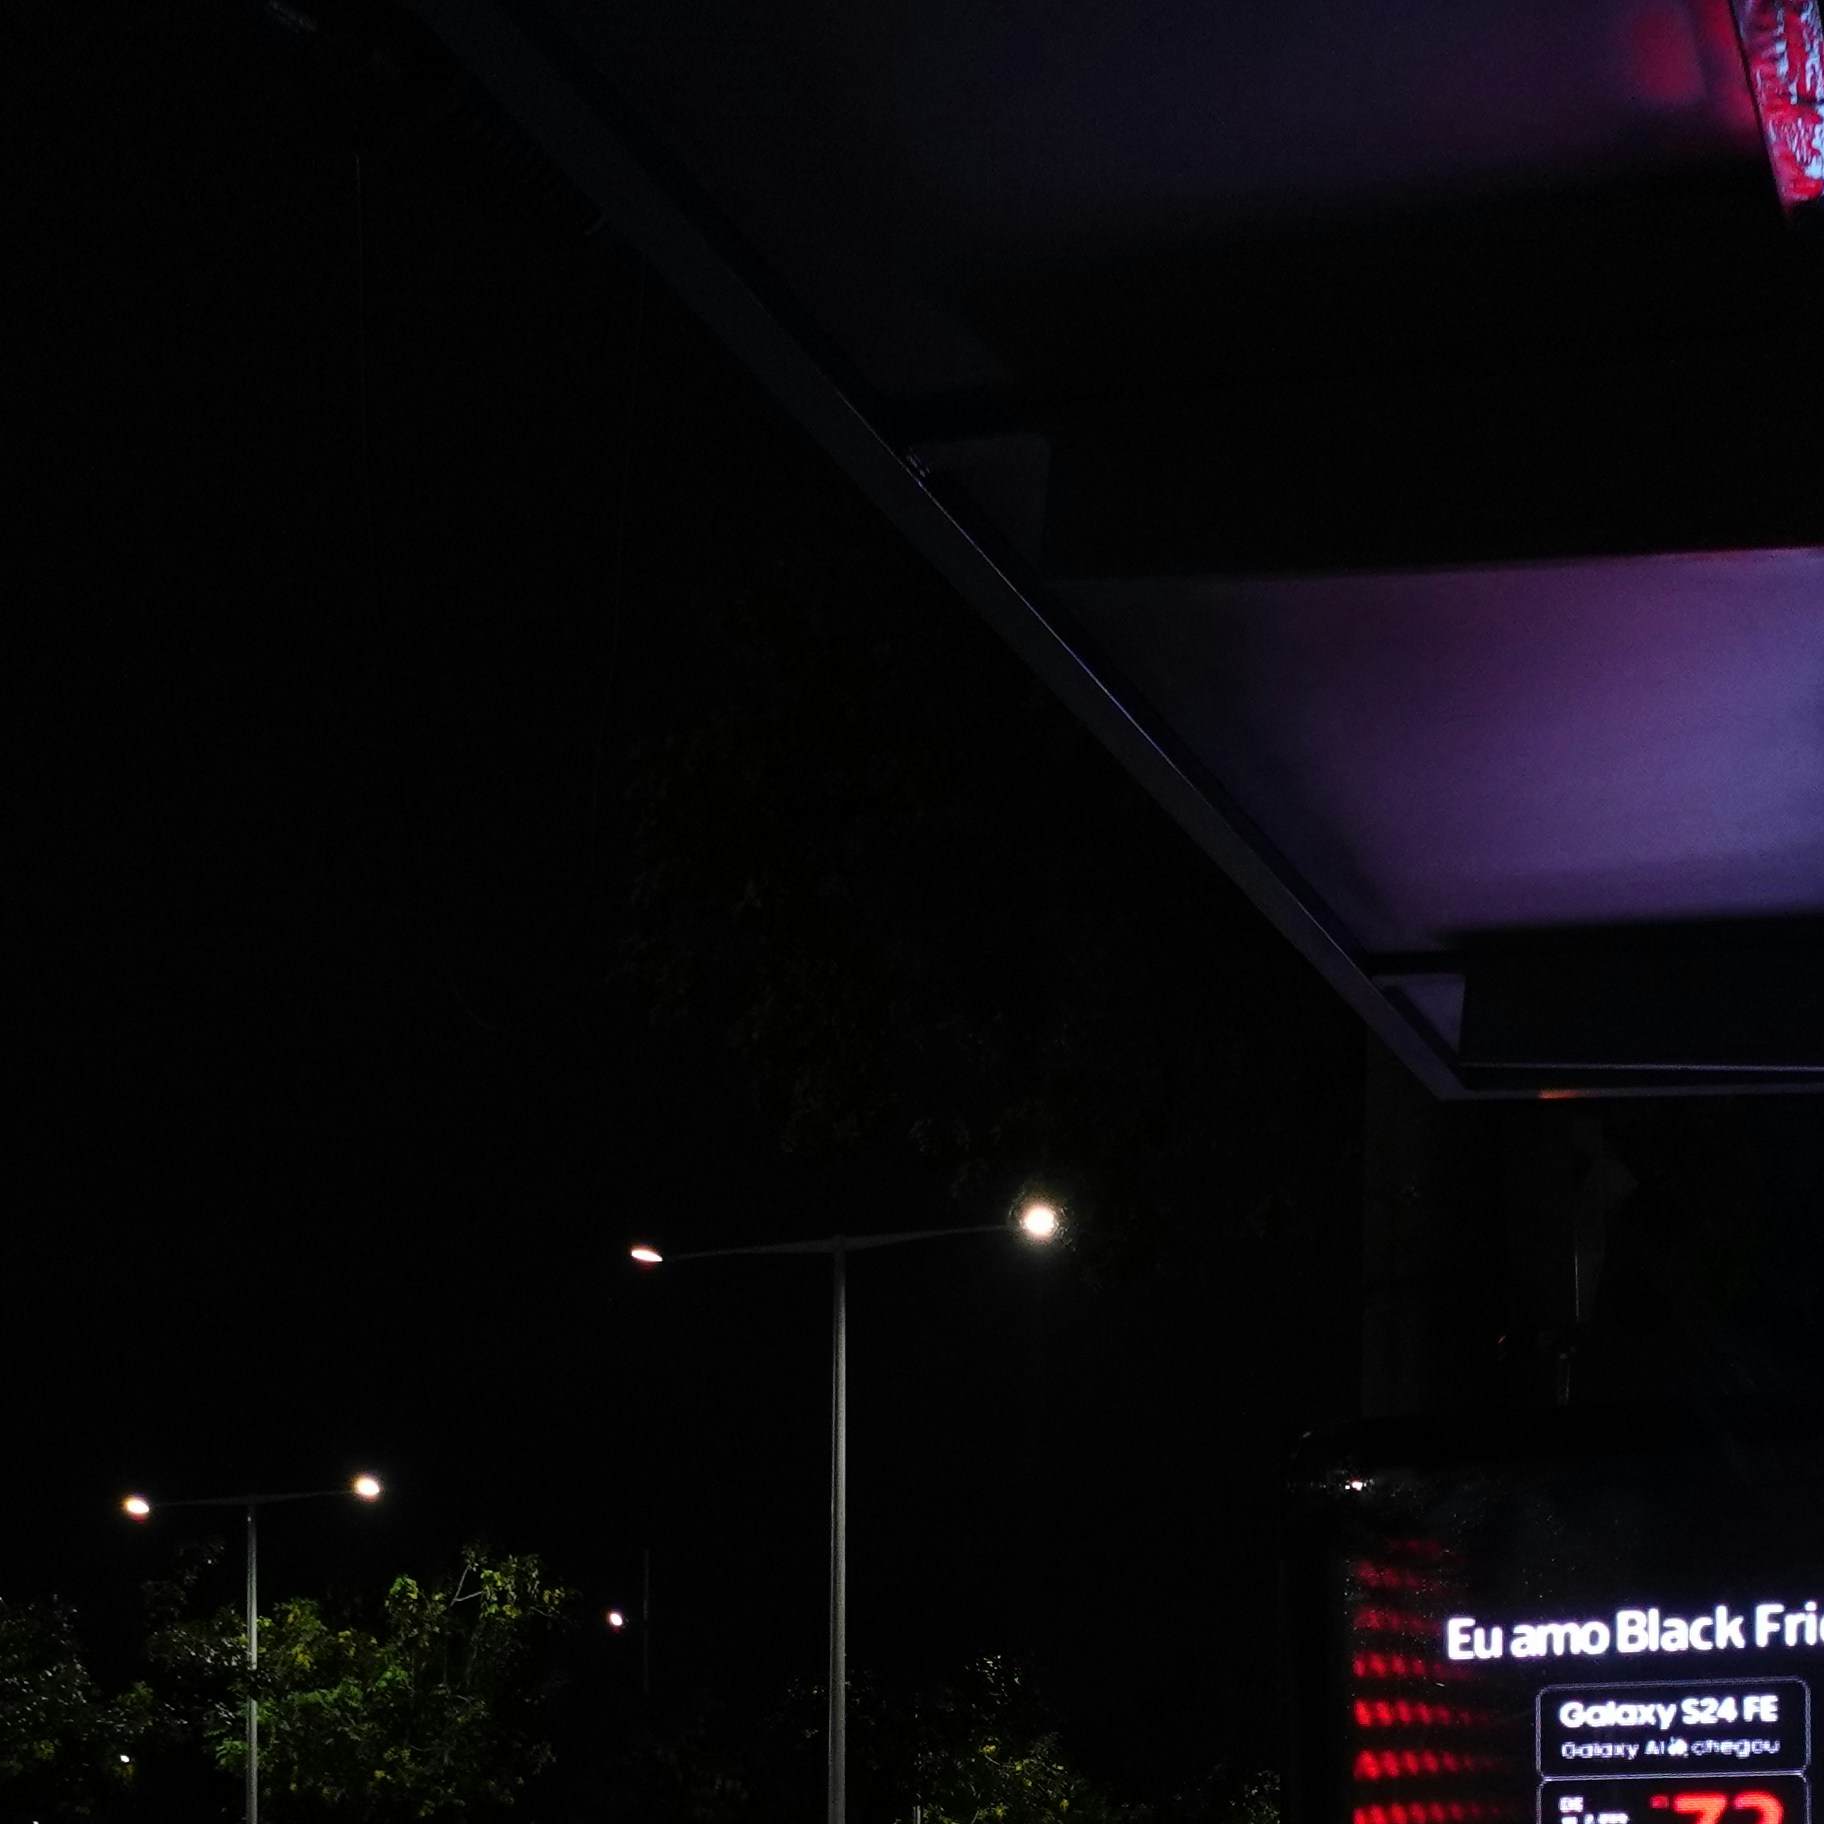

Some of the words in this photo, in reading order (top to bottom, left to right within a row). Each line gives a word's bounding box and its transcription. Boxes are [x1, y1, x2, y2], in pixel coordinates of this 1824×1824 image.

[1447, 1618, 1505, 1661] Eu
[1510, 1620, 1611, 1659] amo
[1615, 1605, 1745, 1654] Black
[1559, 1701, 1677, 1731] Galaxy
[1681, 1697, 1739, 1726] S24
[1741, 1695, 1779, 1723] FE
[1561, 1742, 1640, 1761] Galaxy
[1690, 1740, 1781, 1758] chegou
